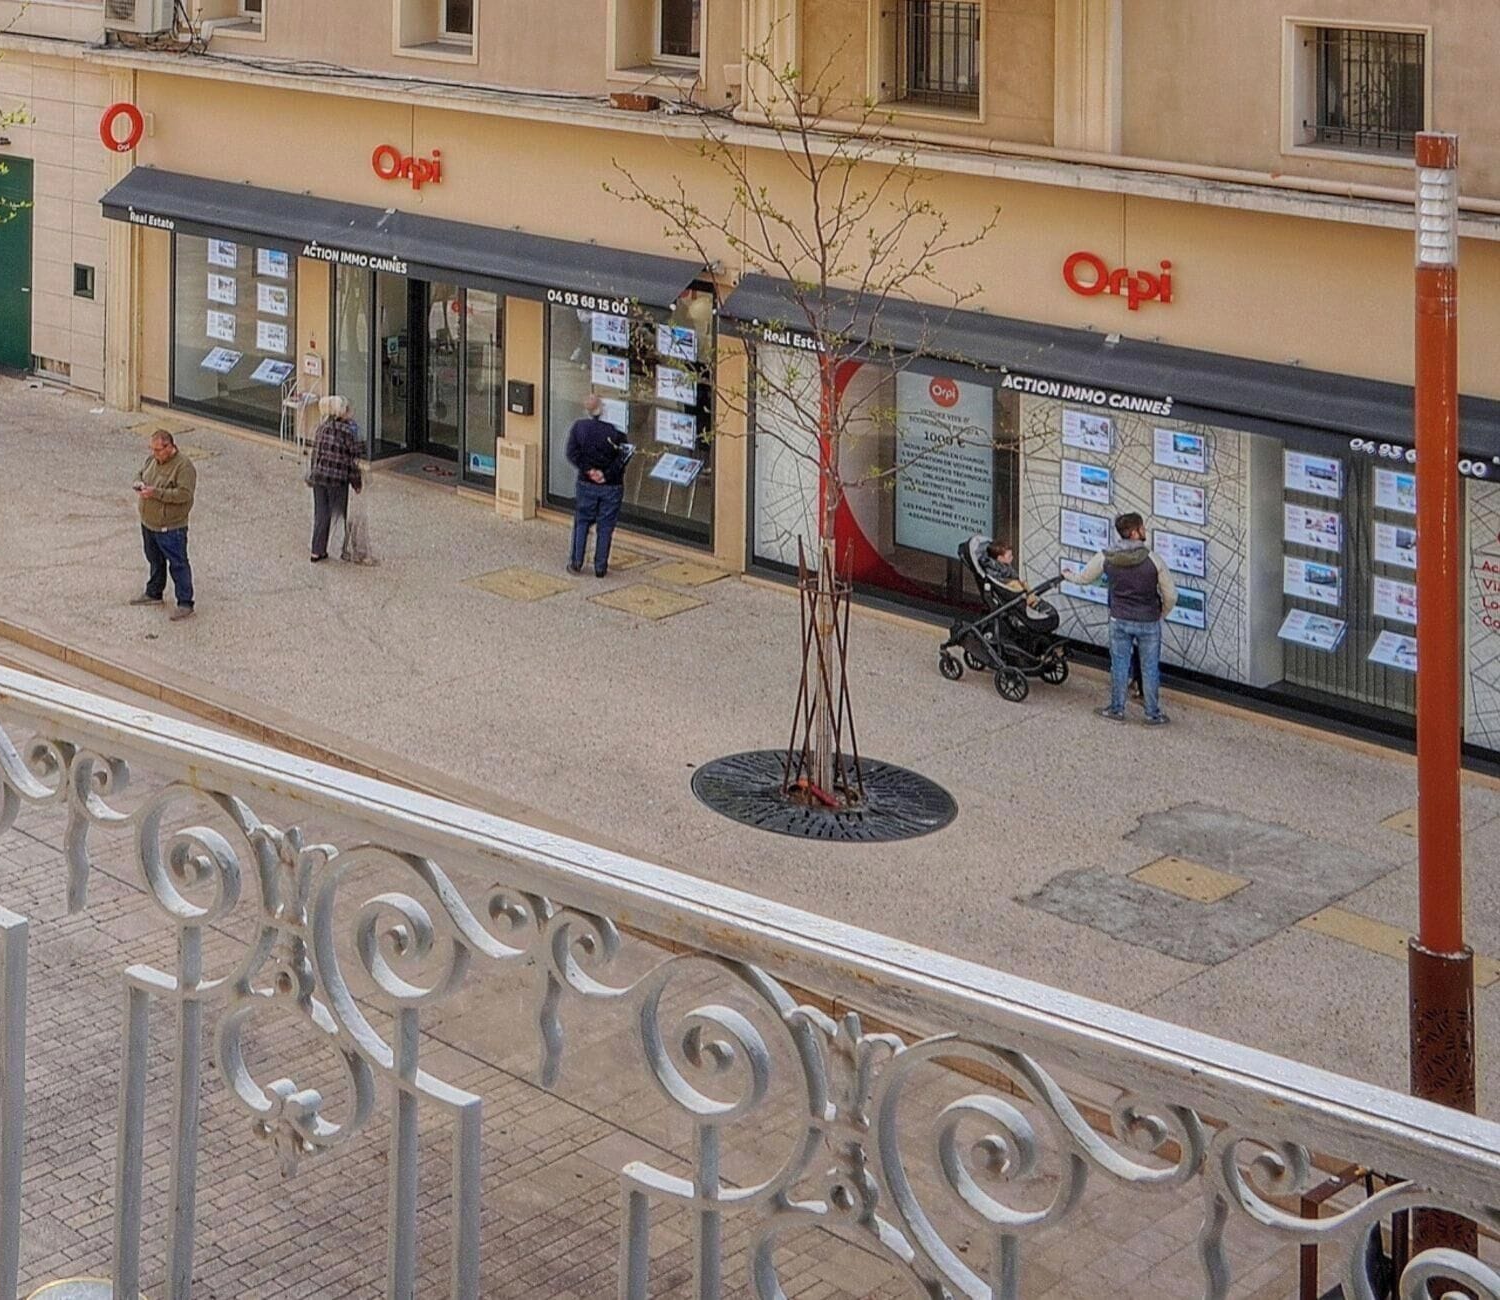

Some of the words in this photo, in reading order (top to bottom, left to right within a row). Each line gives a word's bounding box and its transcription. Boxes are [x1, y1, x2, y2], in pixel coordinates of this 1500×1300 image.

[372, 145, 441, 190] Orpi
[130, 210, 148, 225] Real
[148, 214, 175, 230] Estate
[303, 244, 339, 262] ACTION
[340, 251, 368, 267] IMMO
[369, 256, 408, 275] CANNES
[1062, 251, 1171, 310] Orpi
[547, 289, 564, 303] 04
[564, 292, 579, 306] 93
[580, 295, 596, 309] 68
[597, 298, 610, 311] 15
[611, 301, 629, 315] 00
[763, 328, 791, 345] Real
[931, 384, 956, 400] Orpi
[1001, 374, 1061, 396] ACTION
[1062, 384, 1107, 405] IMMO
[1108, 393, 1173, 416] CANNES
